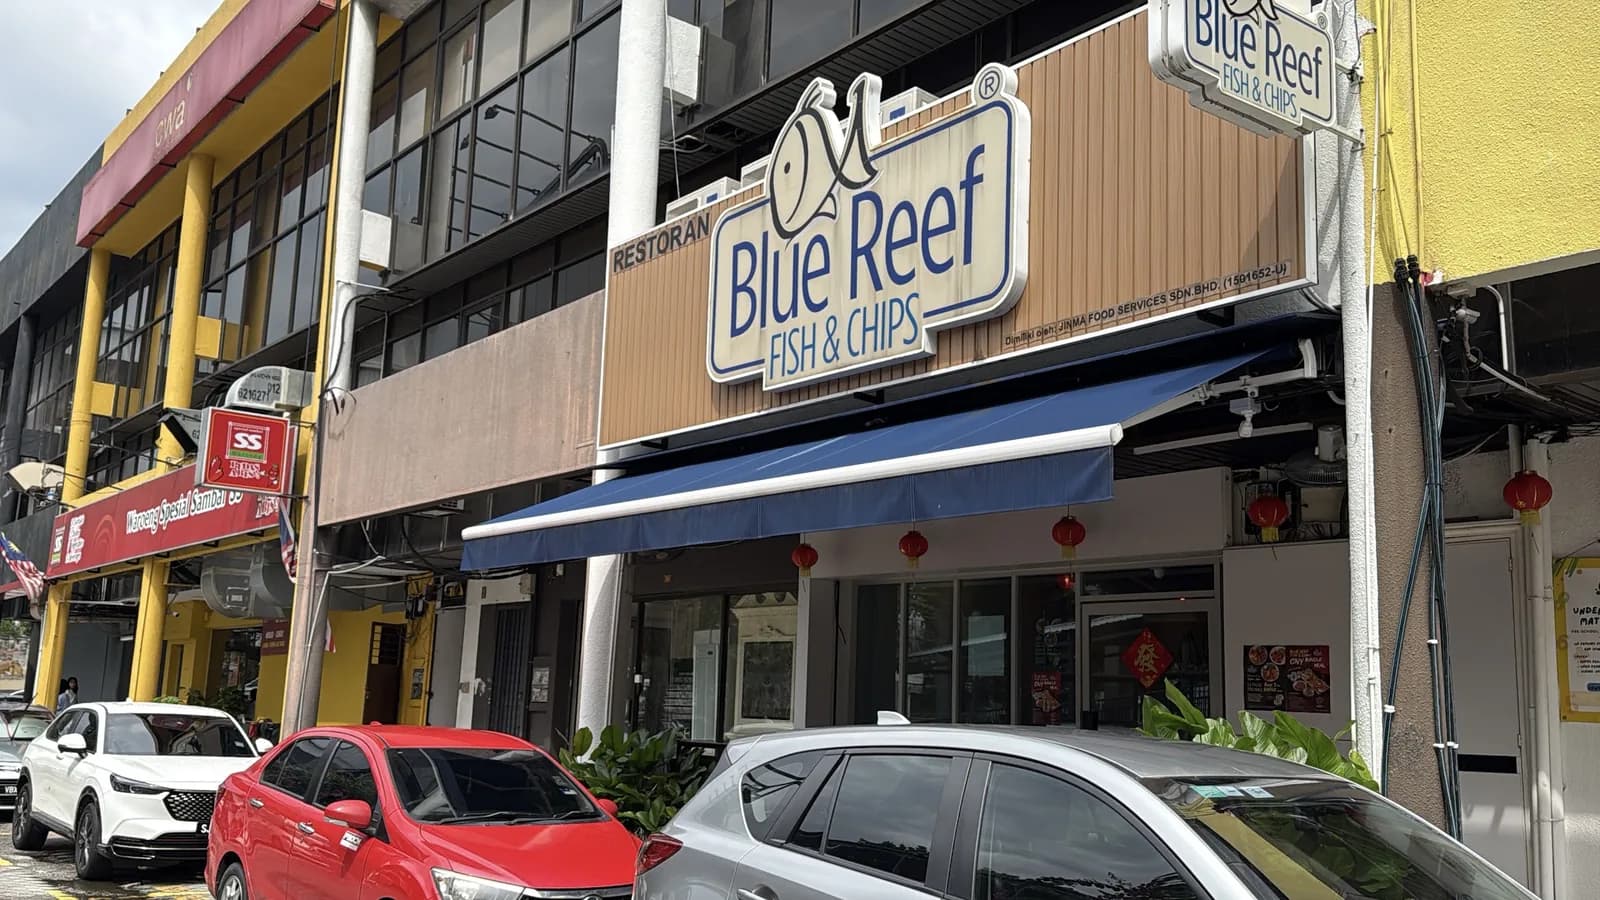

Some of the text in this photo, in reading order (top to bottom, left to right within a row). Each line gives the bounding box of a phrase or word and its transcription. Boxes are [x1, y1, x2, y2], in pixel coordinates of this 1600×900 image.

[1195, 0, 1322, 99] Blue Reef
[1223, 63, 1297, 118] FISH & CHIPS
[613, 213, 710, 272] RESTORAN
[730, 143, 986, 338] Blue Reef
[1005, 330, 1036, 346] Dimiliki
[1059, 315, 1087, 333] JINMA
[1088, 308, 1115, 325] FOOD
[1117, 294, 1167, 316] SERVICES
[1223, 263, 1287, 292] (1501652-U)
[769, 291, 919, 380] FISH & CHIPS
[233, 432, 262, 450] SS
[127, 506, 160, 534] Waroeng
[160, 490, 191, 530] Spesial
[190, 488, 226, 516] Sambal
[1580, 617, 1599, 626] MAT
[200, 824, 209, 834] S
